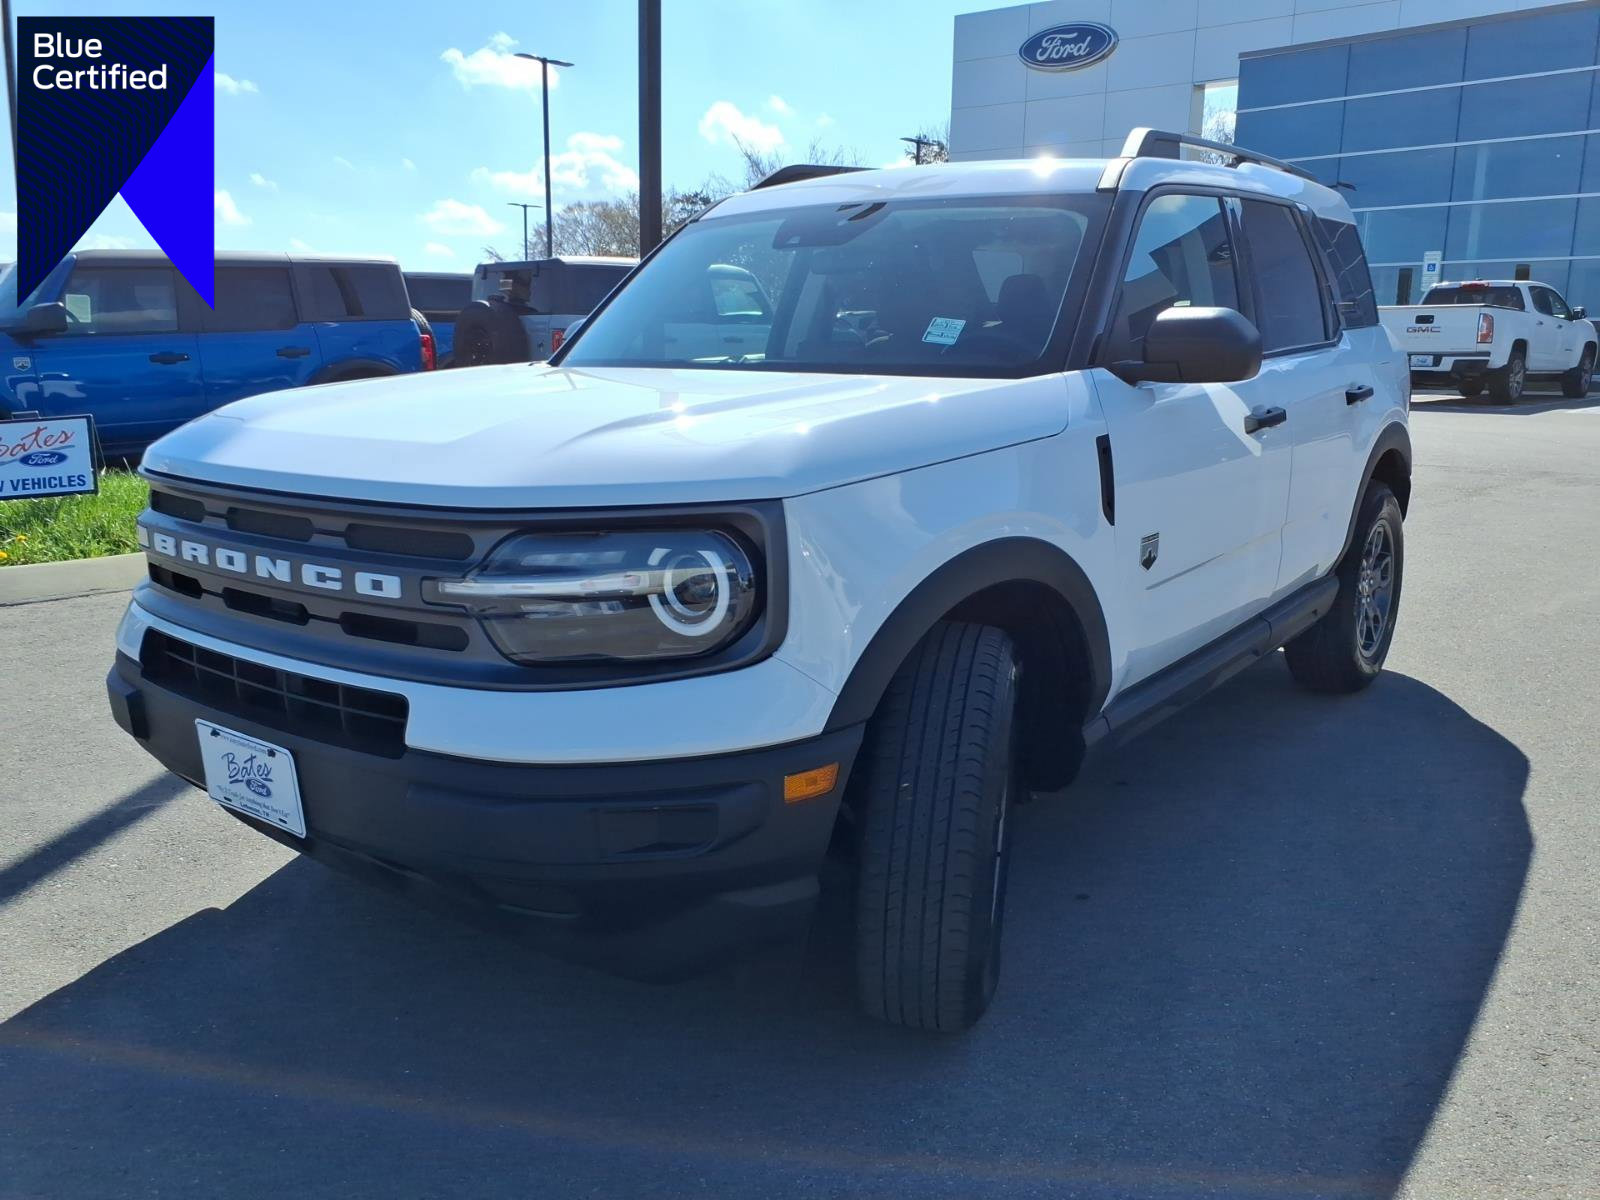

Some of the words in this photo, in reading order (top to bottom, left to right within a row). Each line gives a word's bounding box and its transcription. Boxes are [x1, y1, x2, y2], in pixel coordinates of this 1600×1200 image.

[1036, 33, 1092, 60] Ford
[1406, 326, 1441, 334] GMC
[28, 453, 59, 464] Ford
[10, 474, 87, 491] VEHICLES
[153, 532, 402, 599] BRONCO
[221, 752, 273, 779] Bates
